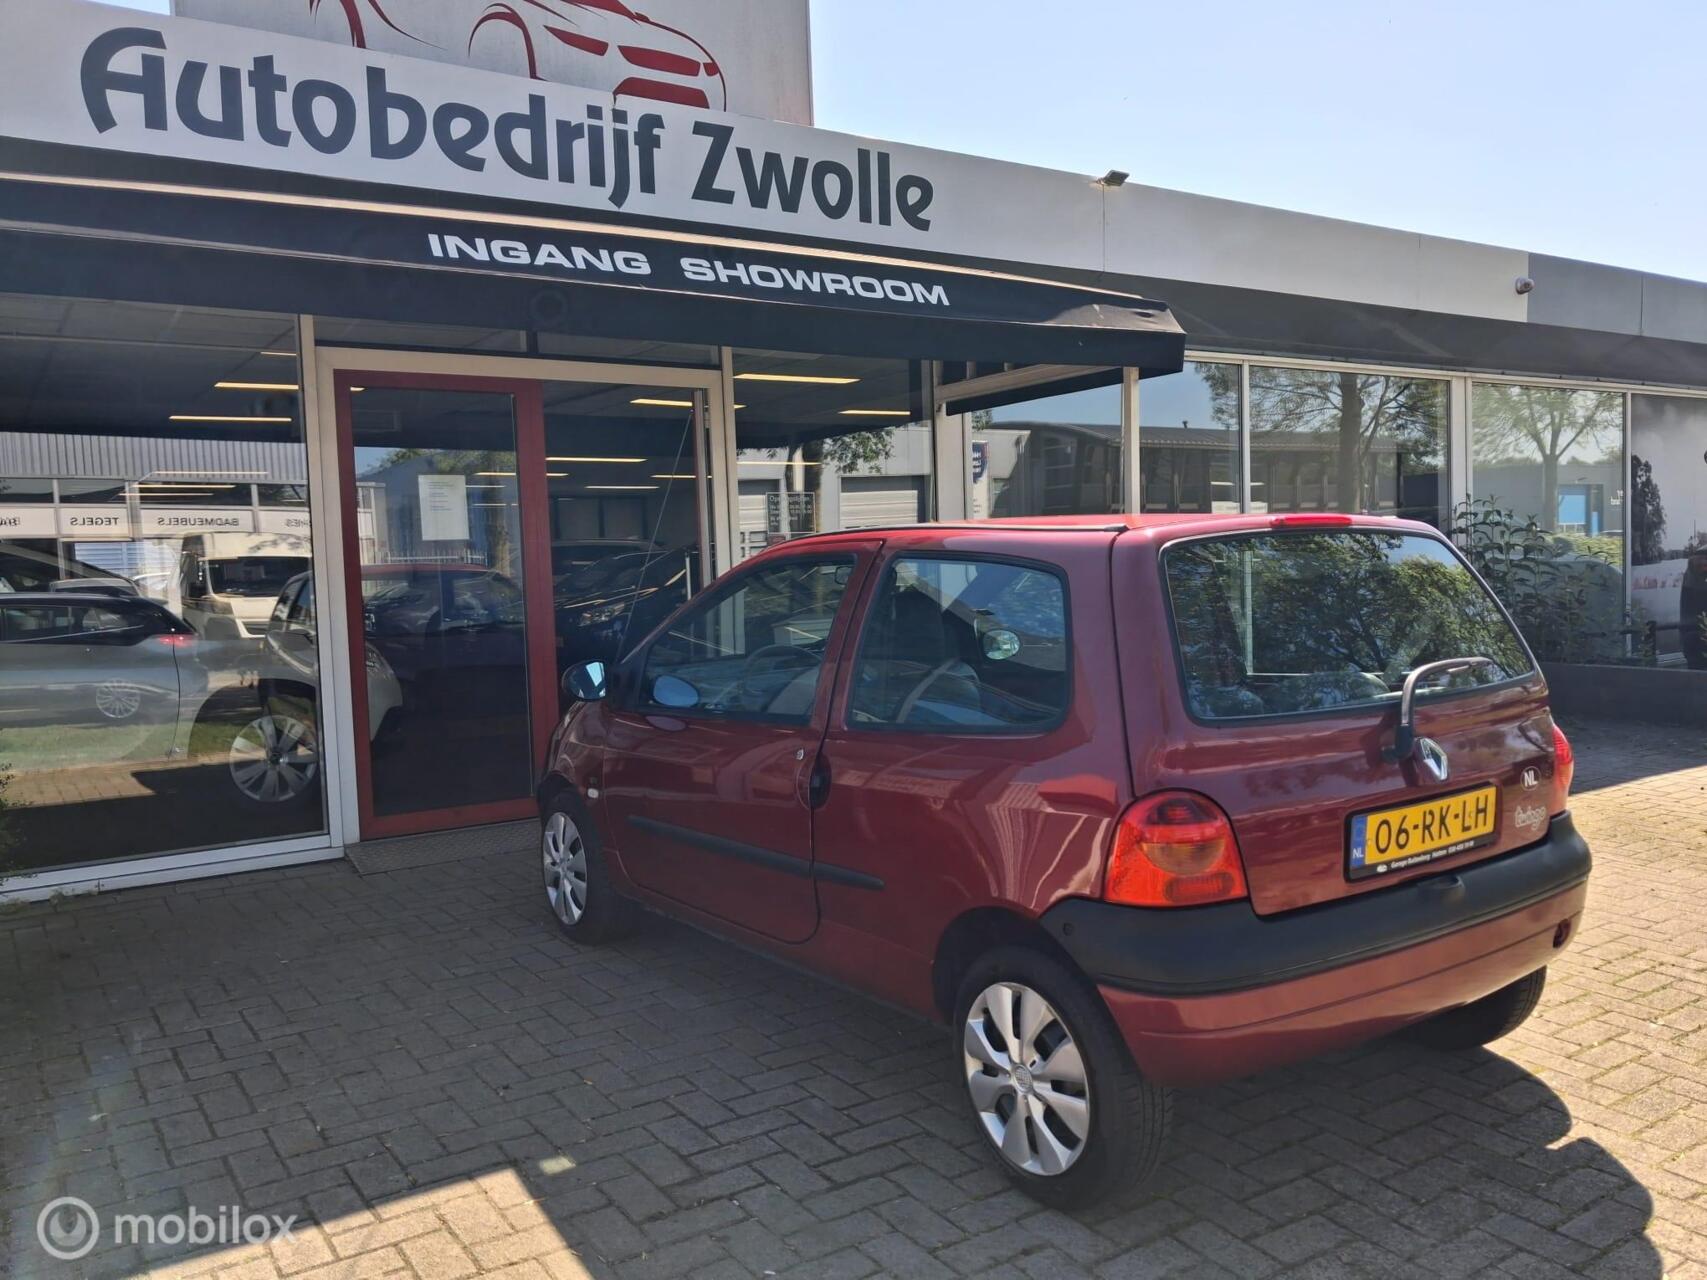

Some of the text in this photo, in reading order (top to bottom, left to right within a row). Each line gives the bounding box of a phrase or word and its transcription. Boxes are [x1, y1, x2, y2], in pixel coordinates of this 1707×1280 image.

[80, 26, 934, 232] Autobedrijf Zwolle
[427, 233, 950, 306] INGANG SHOWROOM
[1524, 769, 1539, 787] NL
[1352, 847, 1365, 859] NL
[1375, 794, 1489, 855] 06-RK-LH
